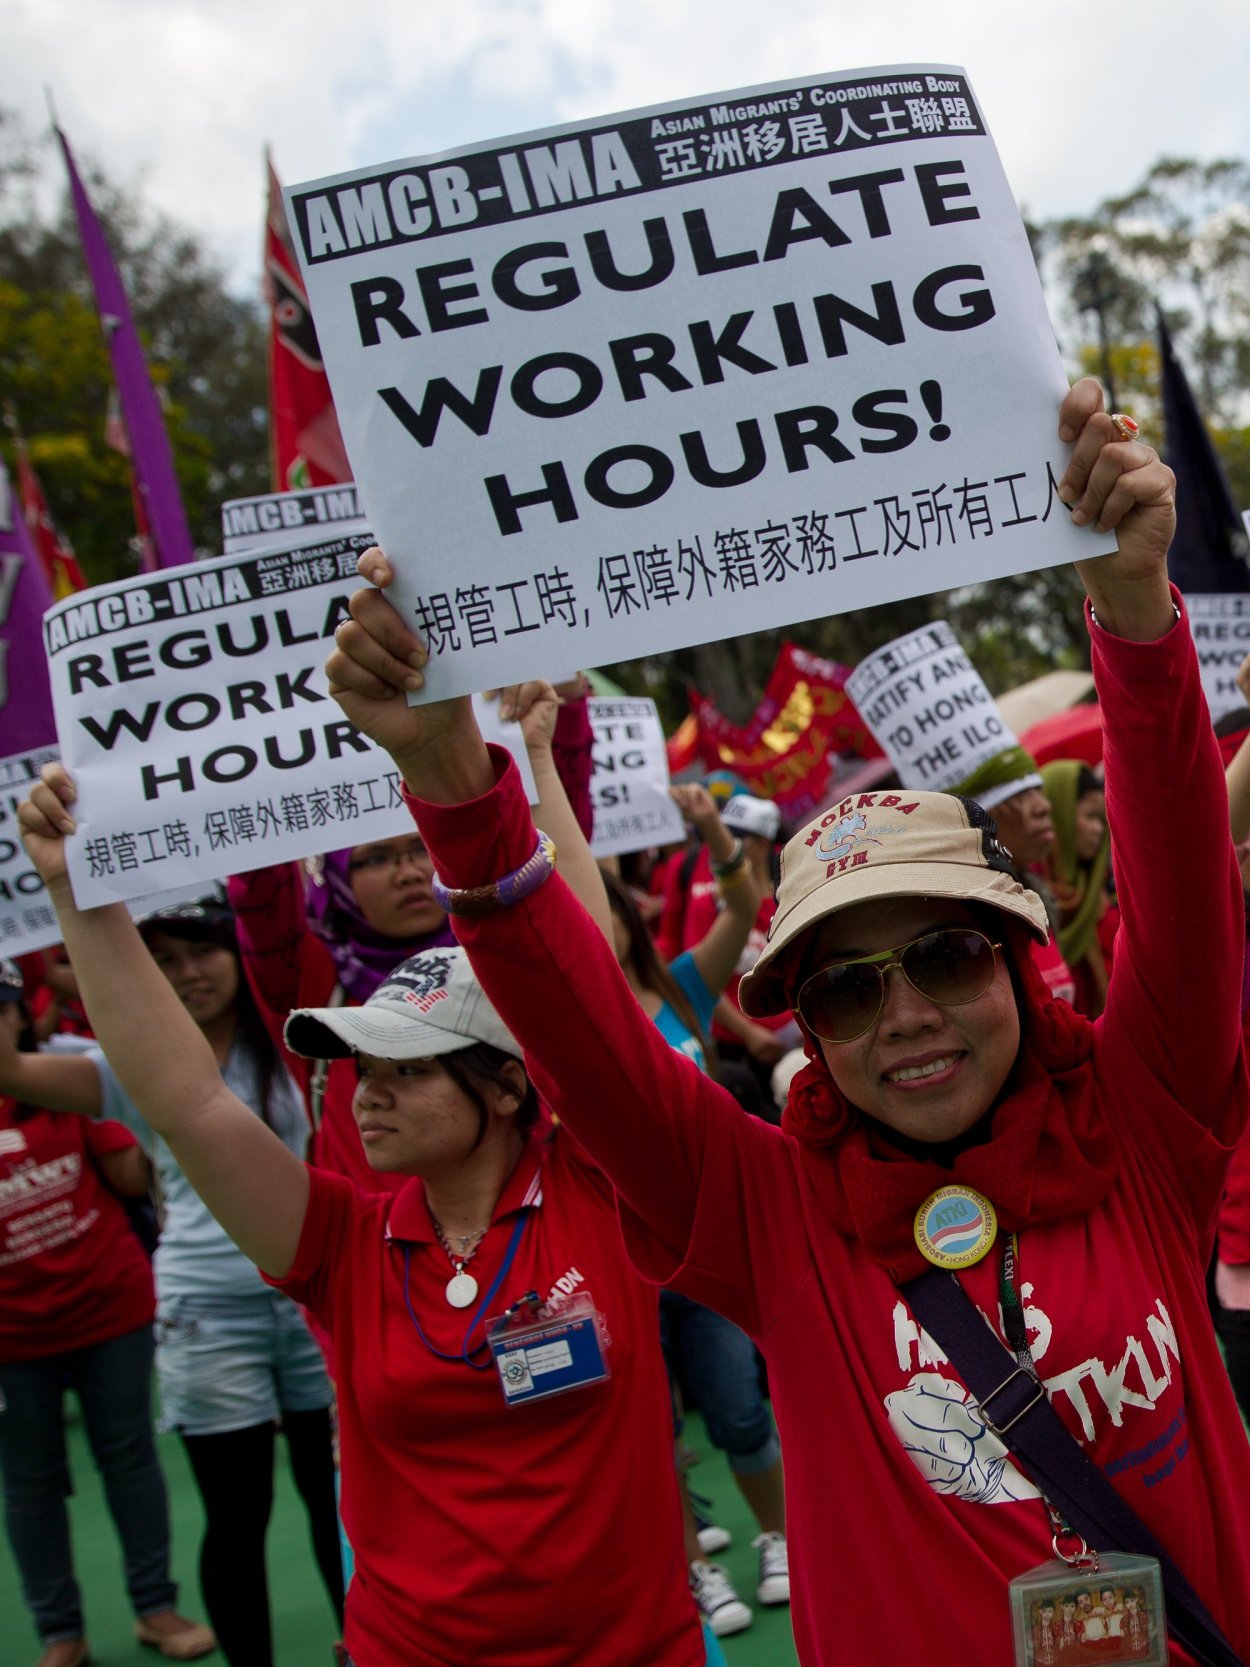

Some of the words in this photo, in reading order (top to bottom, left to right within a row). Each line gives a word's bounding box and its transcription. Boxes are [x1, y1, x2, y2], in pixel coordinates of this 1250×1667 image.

[650, 115, 705, 140] ASIAN
[709, 91, 804, 127] MIGRANTS'
[809, 79, 923, 108] COORDINATING
[924, 75, 961, 95] BODY
[654, 96, 978, 181] 亞洲移居人士聯盟
[305, 130, 643, 259] AMCB-IMA
[350, 160, 981, 348] REGULATE
[377, 263, 997, 448] WORKING
[483, 379, 952, 536] HOURS!
[224, 489, 366, 537] MCB-IM
[49, 568, 252, 653] AMCB-IMA
[78, 666, 327, 751] WORK
[912, 737, 962, 780] THE
[962, 715, 1003, 749] ILO
[935, 1199, 968, 1229] ATKI
[949, 1254, 971, 1264] HONG
